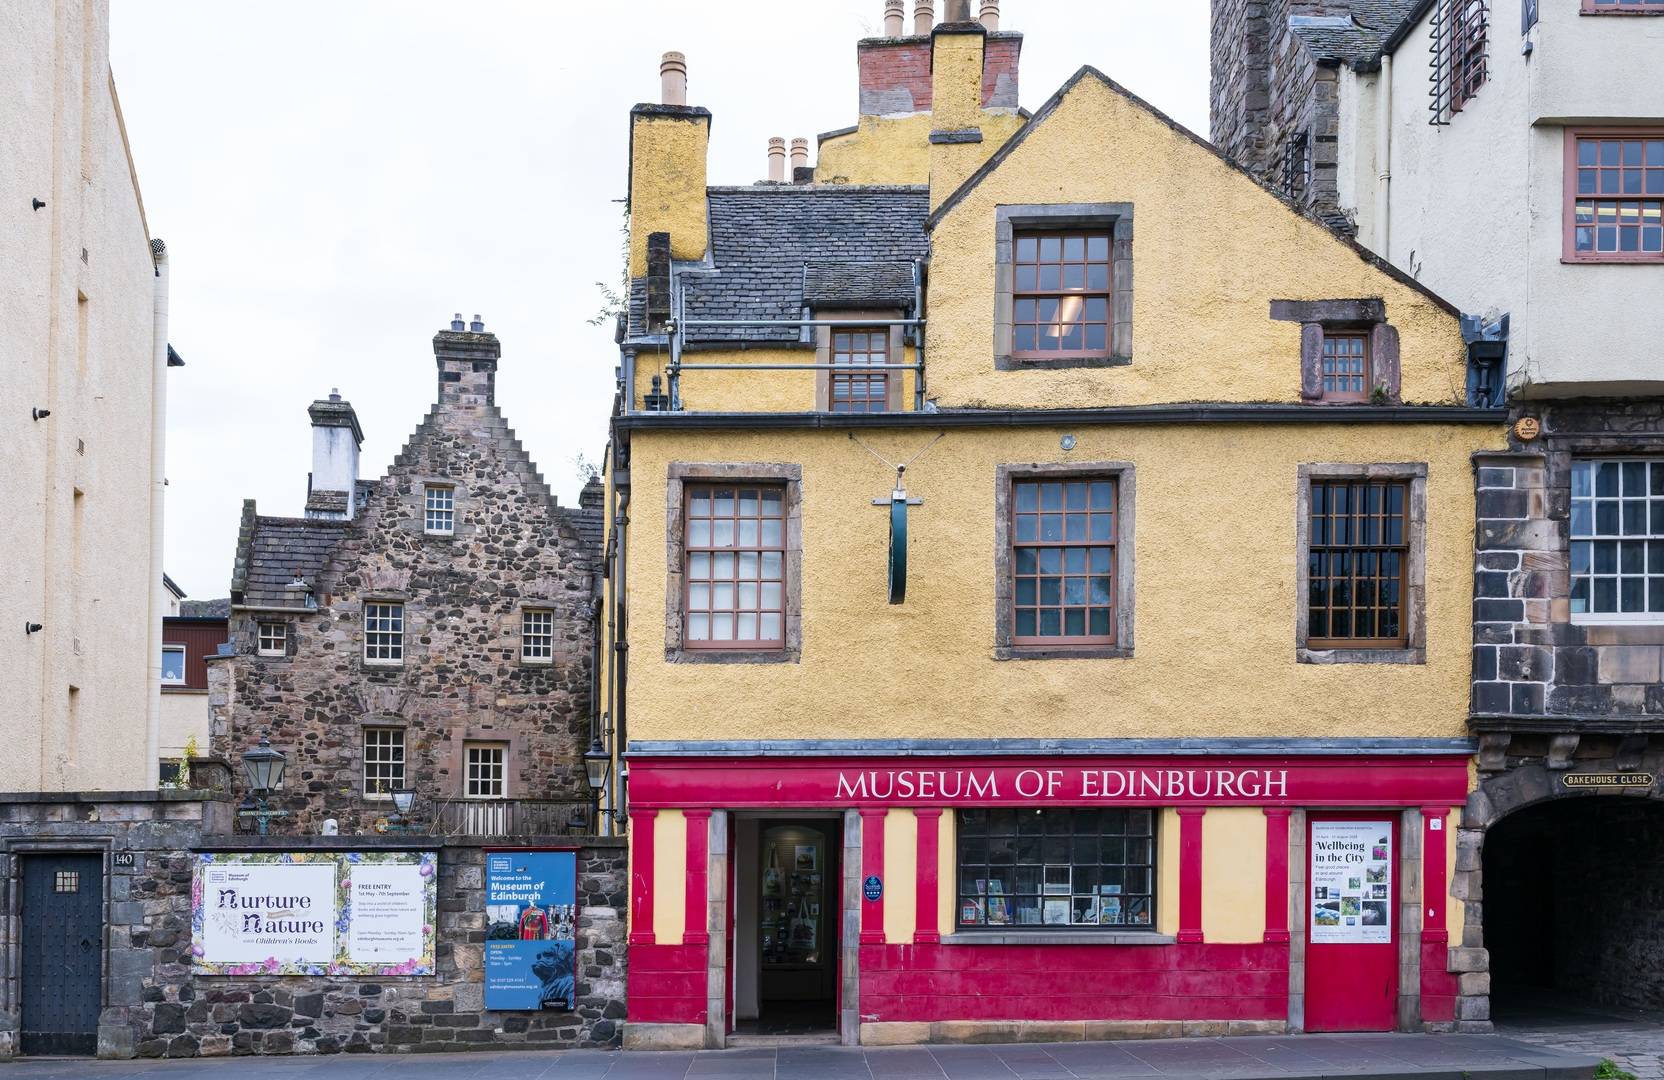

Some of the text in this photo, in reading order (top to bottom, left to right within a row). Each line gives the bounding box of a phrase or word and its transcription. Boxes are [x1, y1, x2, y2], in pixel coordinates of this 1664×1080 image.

[834, 770, 1288, 798] MUSEUM OF EDINBURGH
[1568, 775, 1648, 784] BAKEHOUSE CLOSE
[1315, 841, 1365, 852] Wellbeing
[115, 854, 133, 864] 140
[1328, 853, 1342, 862] the
[1345, 853, 1364, 864] City
[491, 881, 545, 890] Museum of
[218, 889, 311, 909] Nurture
[491, 892, 541, 902] Edinburgh
[242, 914, 324, 934] Nature
